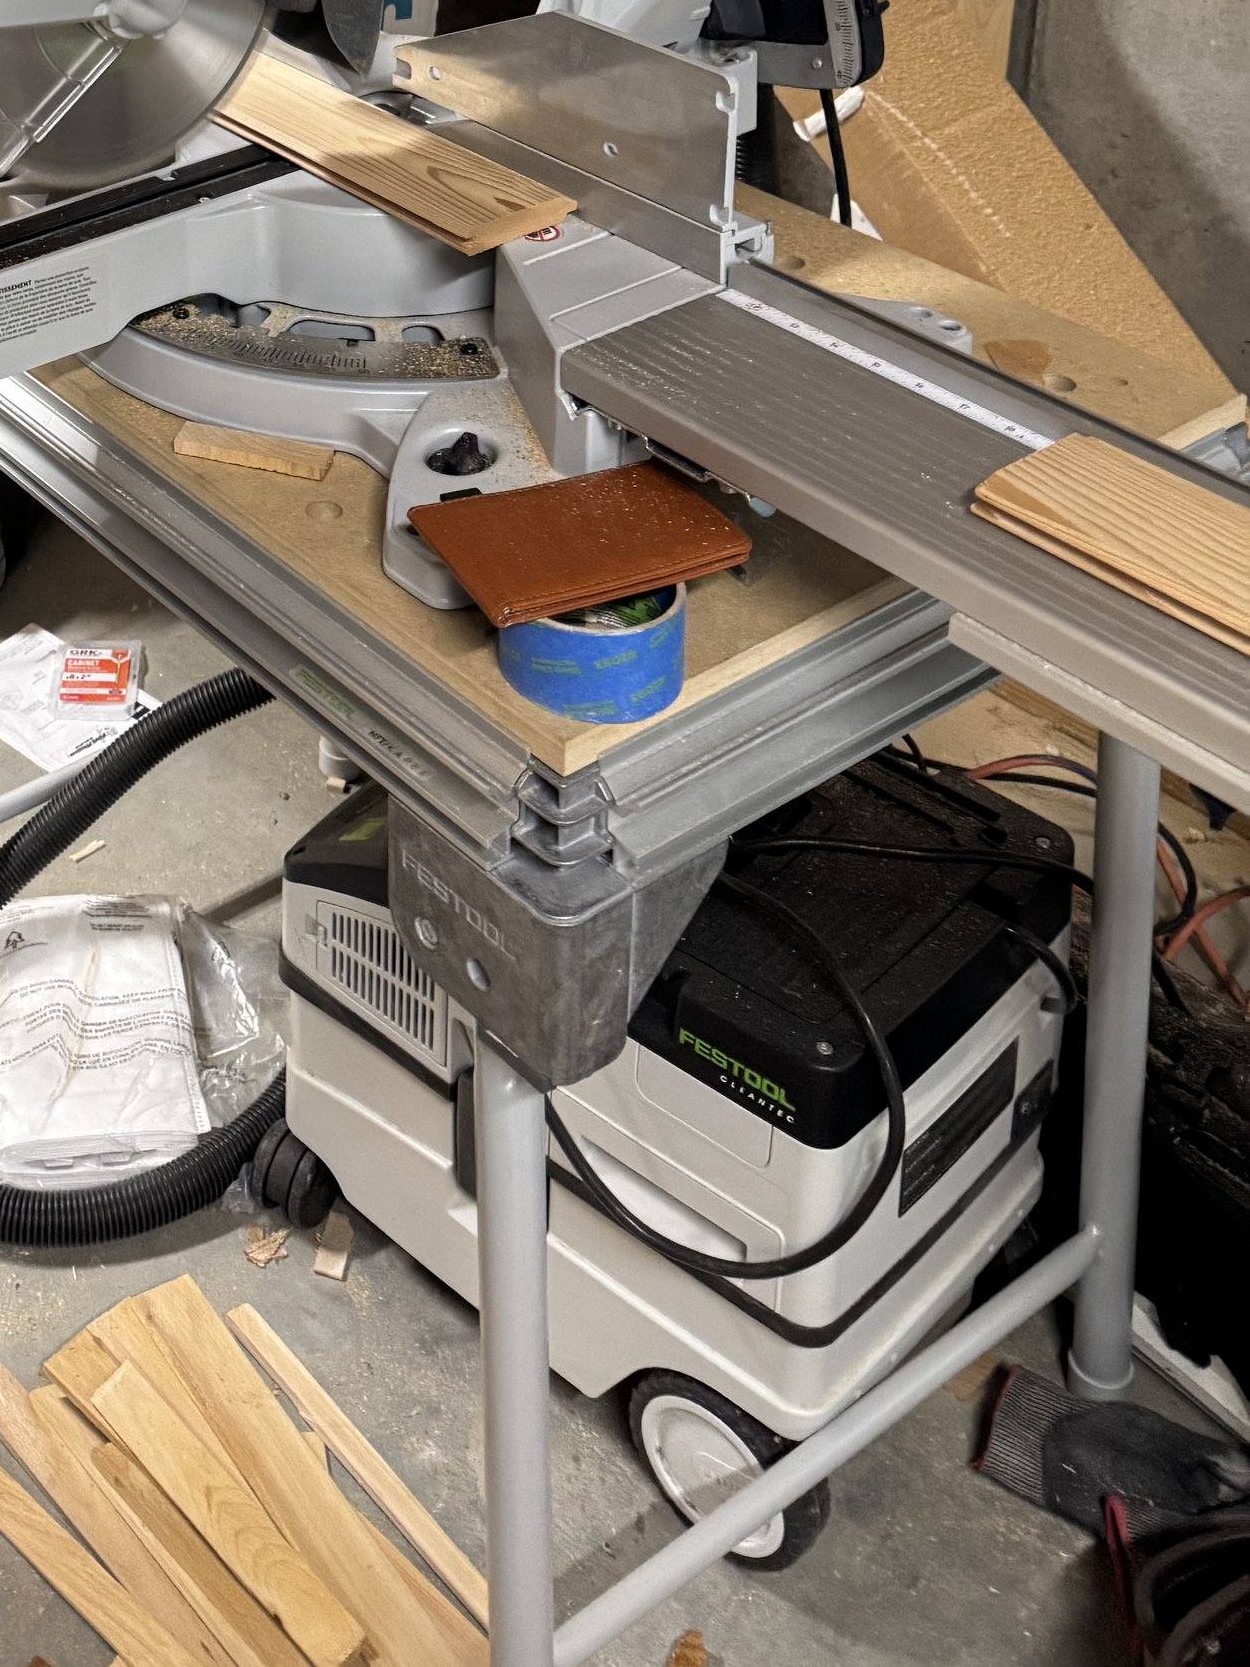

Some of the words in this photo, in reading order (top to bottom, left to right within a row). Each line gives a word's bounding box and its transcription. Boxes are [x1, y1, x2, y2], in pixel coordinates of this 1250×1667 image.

[67, 659, 101, 667] CABINET
[401, 849, 517, 963] FESTOOL
[678, 1026, 797, 1112] FESTOOL
[719, 1074, 795, 1125] CLEANTEC
